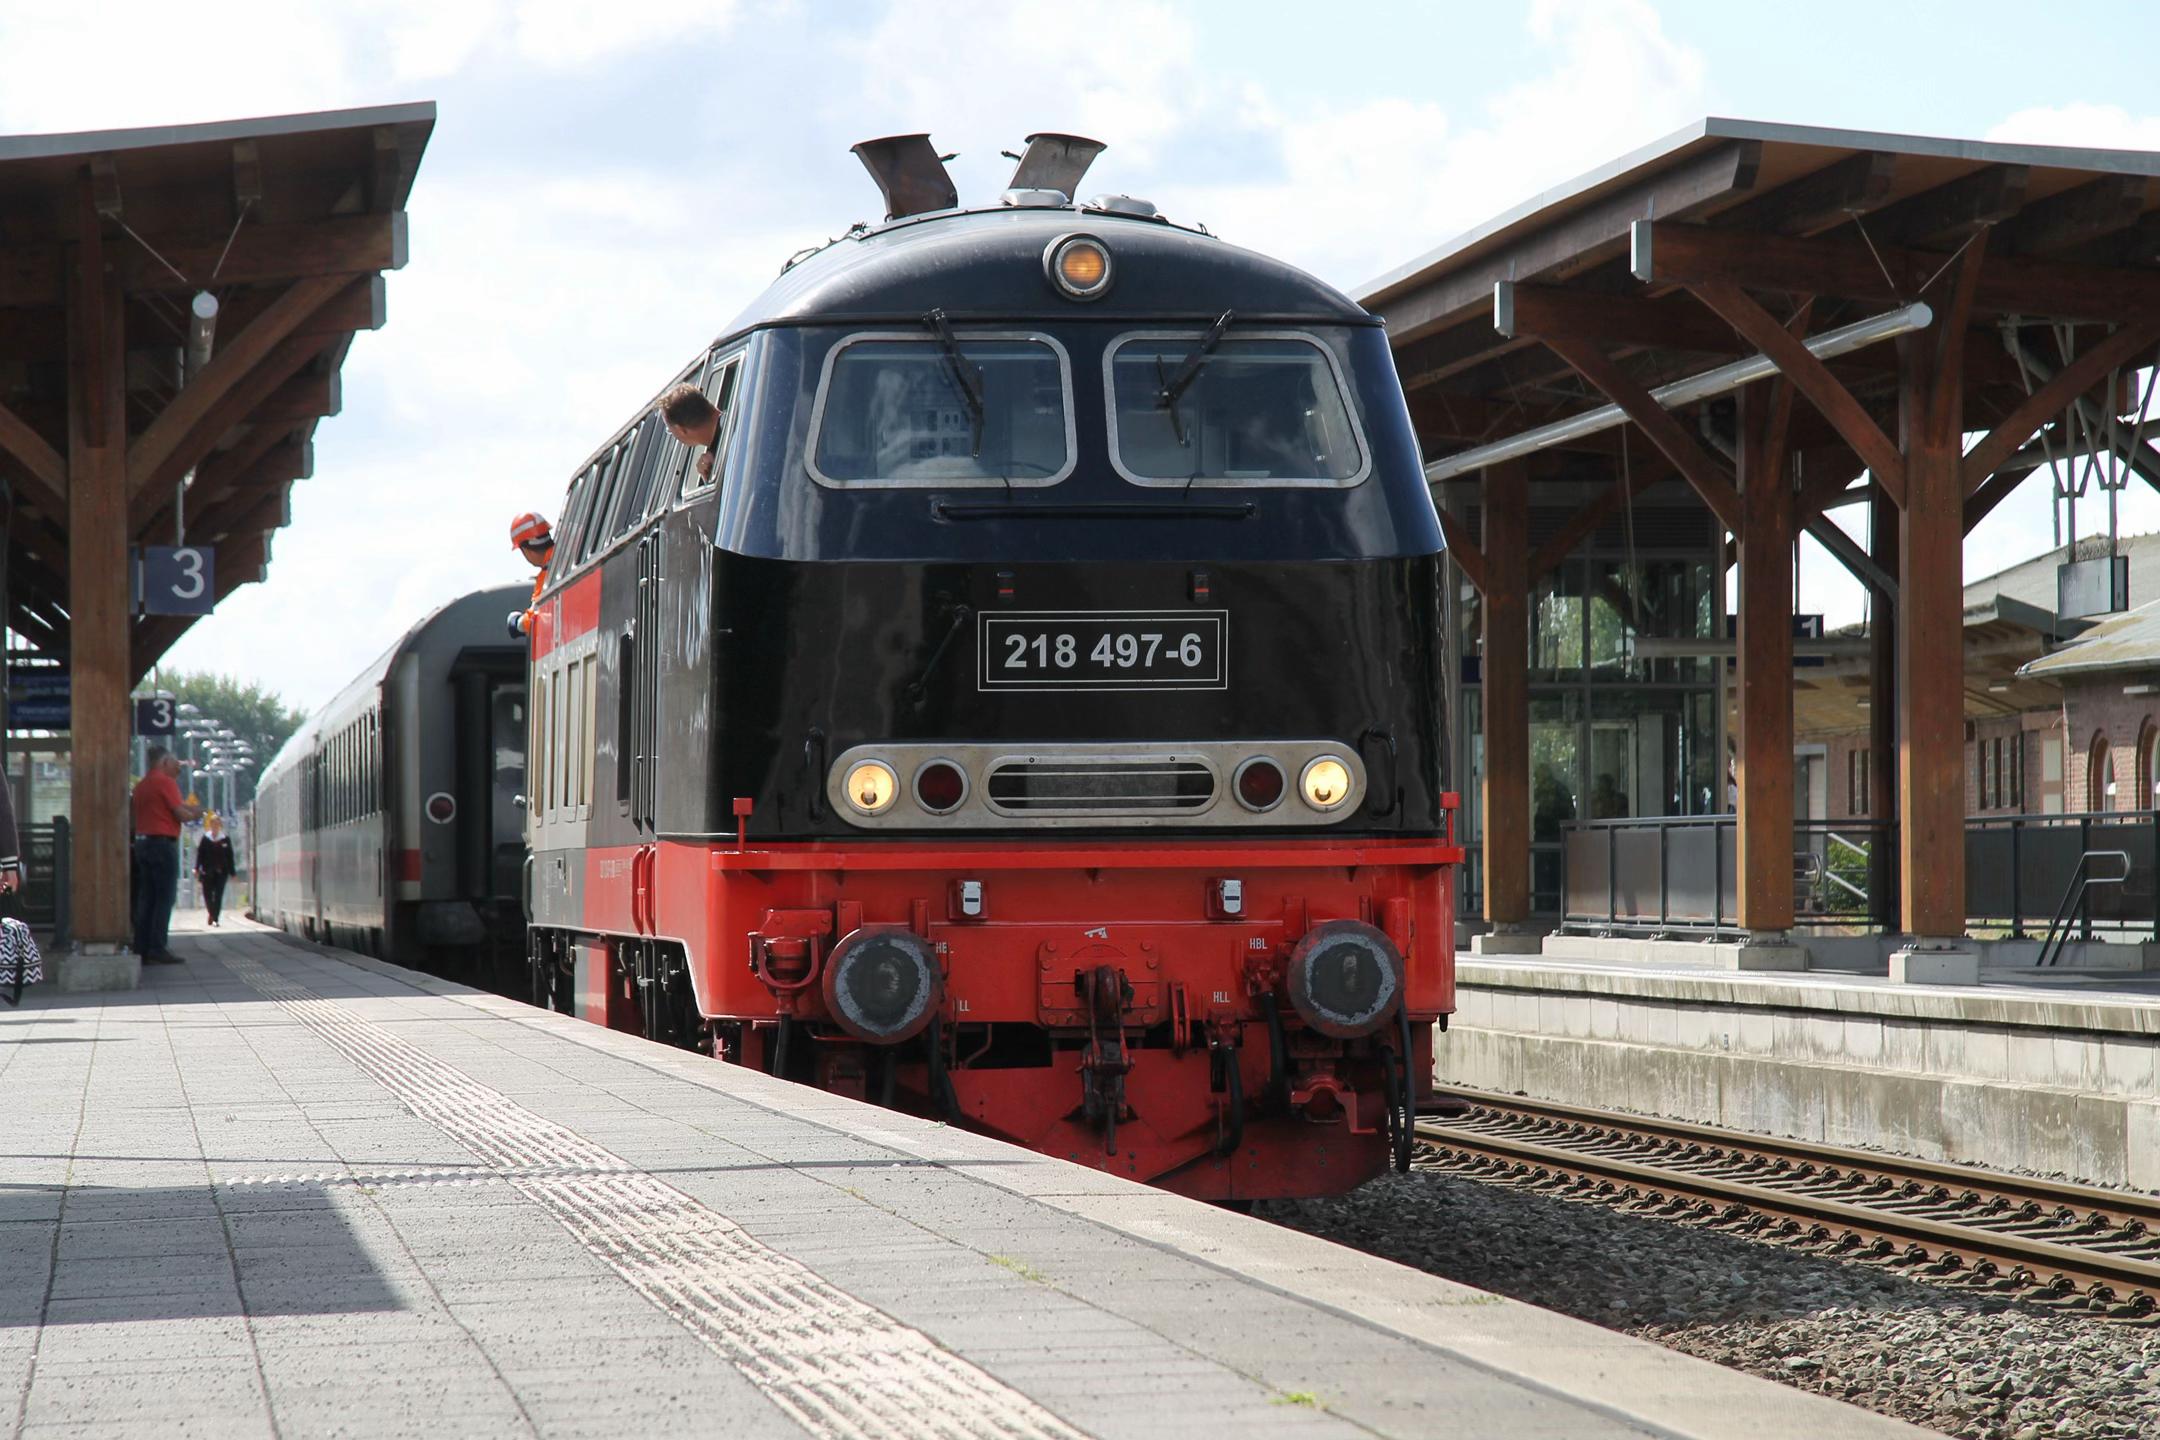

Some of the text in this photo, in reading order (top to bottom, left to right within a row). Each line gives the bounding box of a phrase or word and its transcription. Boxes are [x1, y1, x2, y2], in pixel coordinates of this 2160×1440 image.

[170, 547, 206, 599] 3
[1004, 632, 1202, 668] 218 497-6
[151, 699, 172, 729] 3
[1249, 937, 1268, 950] HBL
[1213, 991, 1231, 1003] HLL
